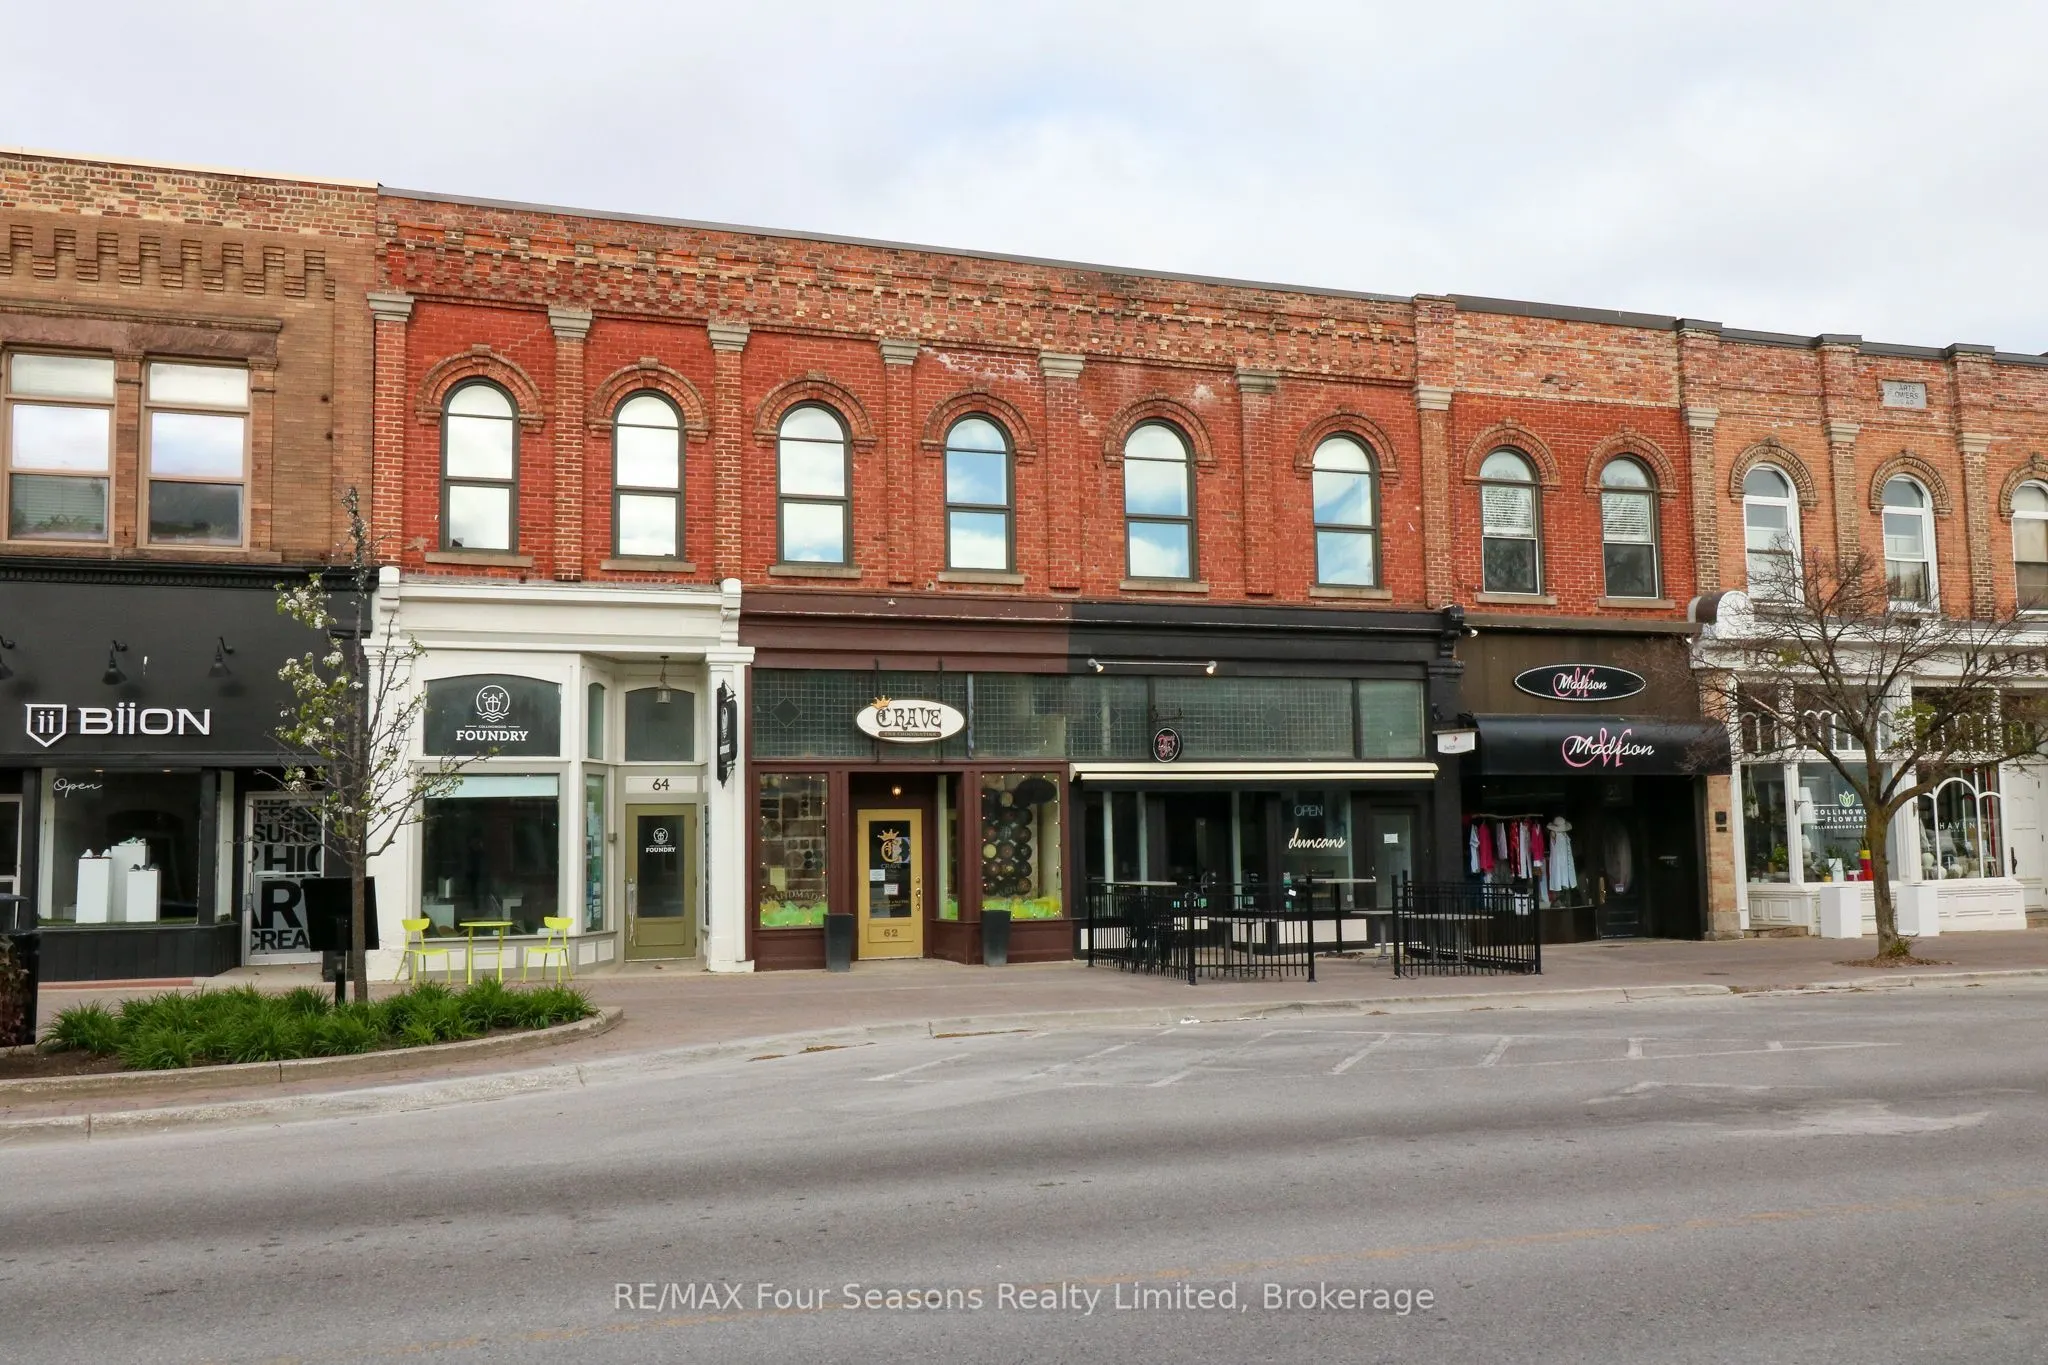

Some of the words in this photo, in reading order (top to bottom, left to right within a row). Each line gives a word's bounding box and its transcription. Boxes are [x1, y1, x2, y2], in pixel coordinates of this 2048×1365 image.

[1557, 673, 1608, 691] Madison
[498, 692, 504, 700] F
[876, 707, 942, 731] CRAVE
[456, 730, 529, 742] FOUNDRY
[1568, 736, 1655, 757] Madison
[53, 777, 103, 798] Open
[652, 778, 670, 791] 64
[1294, 804, 1323, 817] OPEN
[252, 823, 321, 844] SURE
[1288, 827, 1346, 849] duncans
[883, 928, 898, 938] 62
